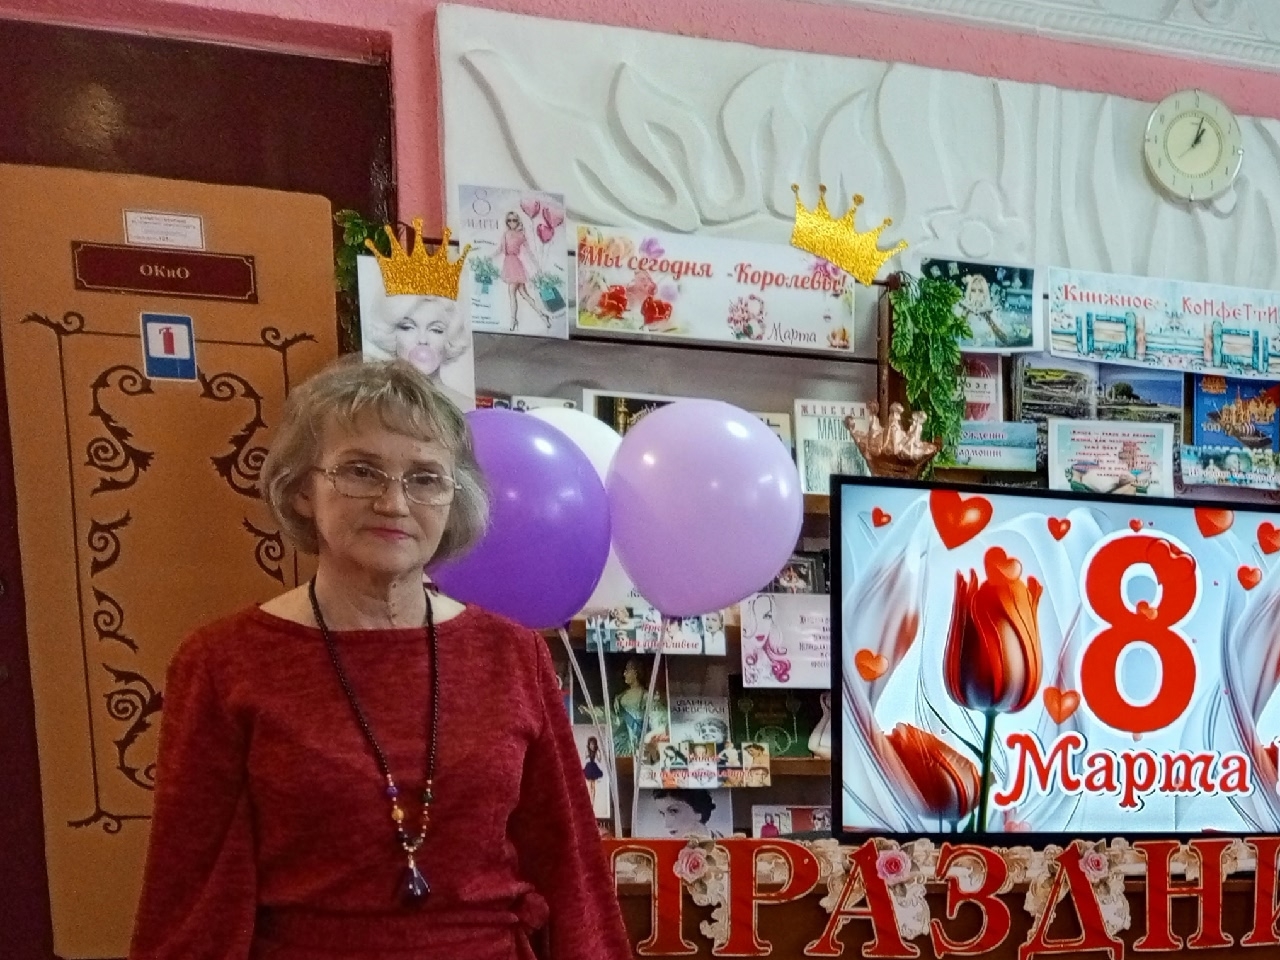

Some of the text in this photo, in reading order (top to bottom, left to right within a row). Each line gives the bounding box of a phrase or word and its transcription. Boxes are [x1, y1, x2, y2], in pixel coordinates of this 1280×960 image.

[580, 244, 623, 269] Мы
[627, 255, 713, 281] сегодня
[1062, 284, 1154, 310] Книжное
[767, 321, 817, 345] Марта
[817, 416, 853, 441] МАГИ
[1079, 533, 1197, 734] 8
[994, 732, 1251, 812] Марта
